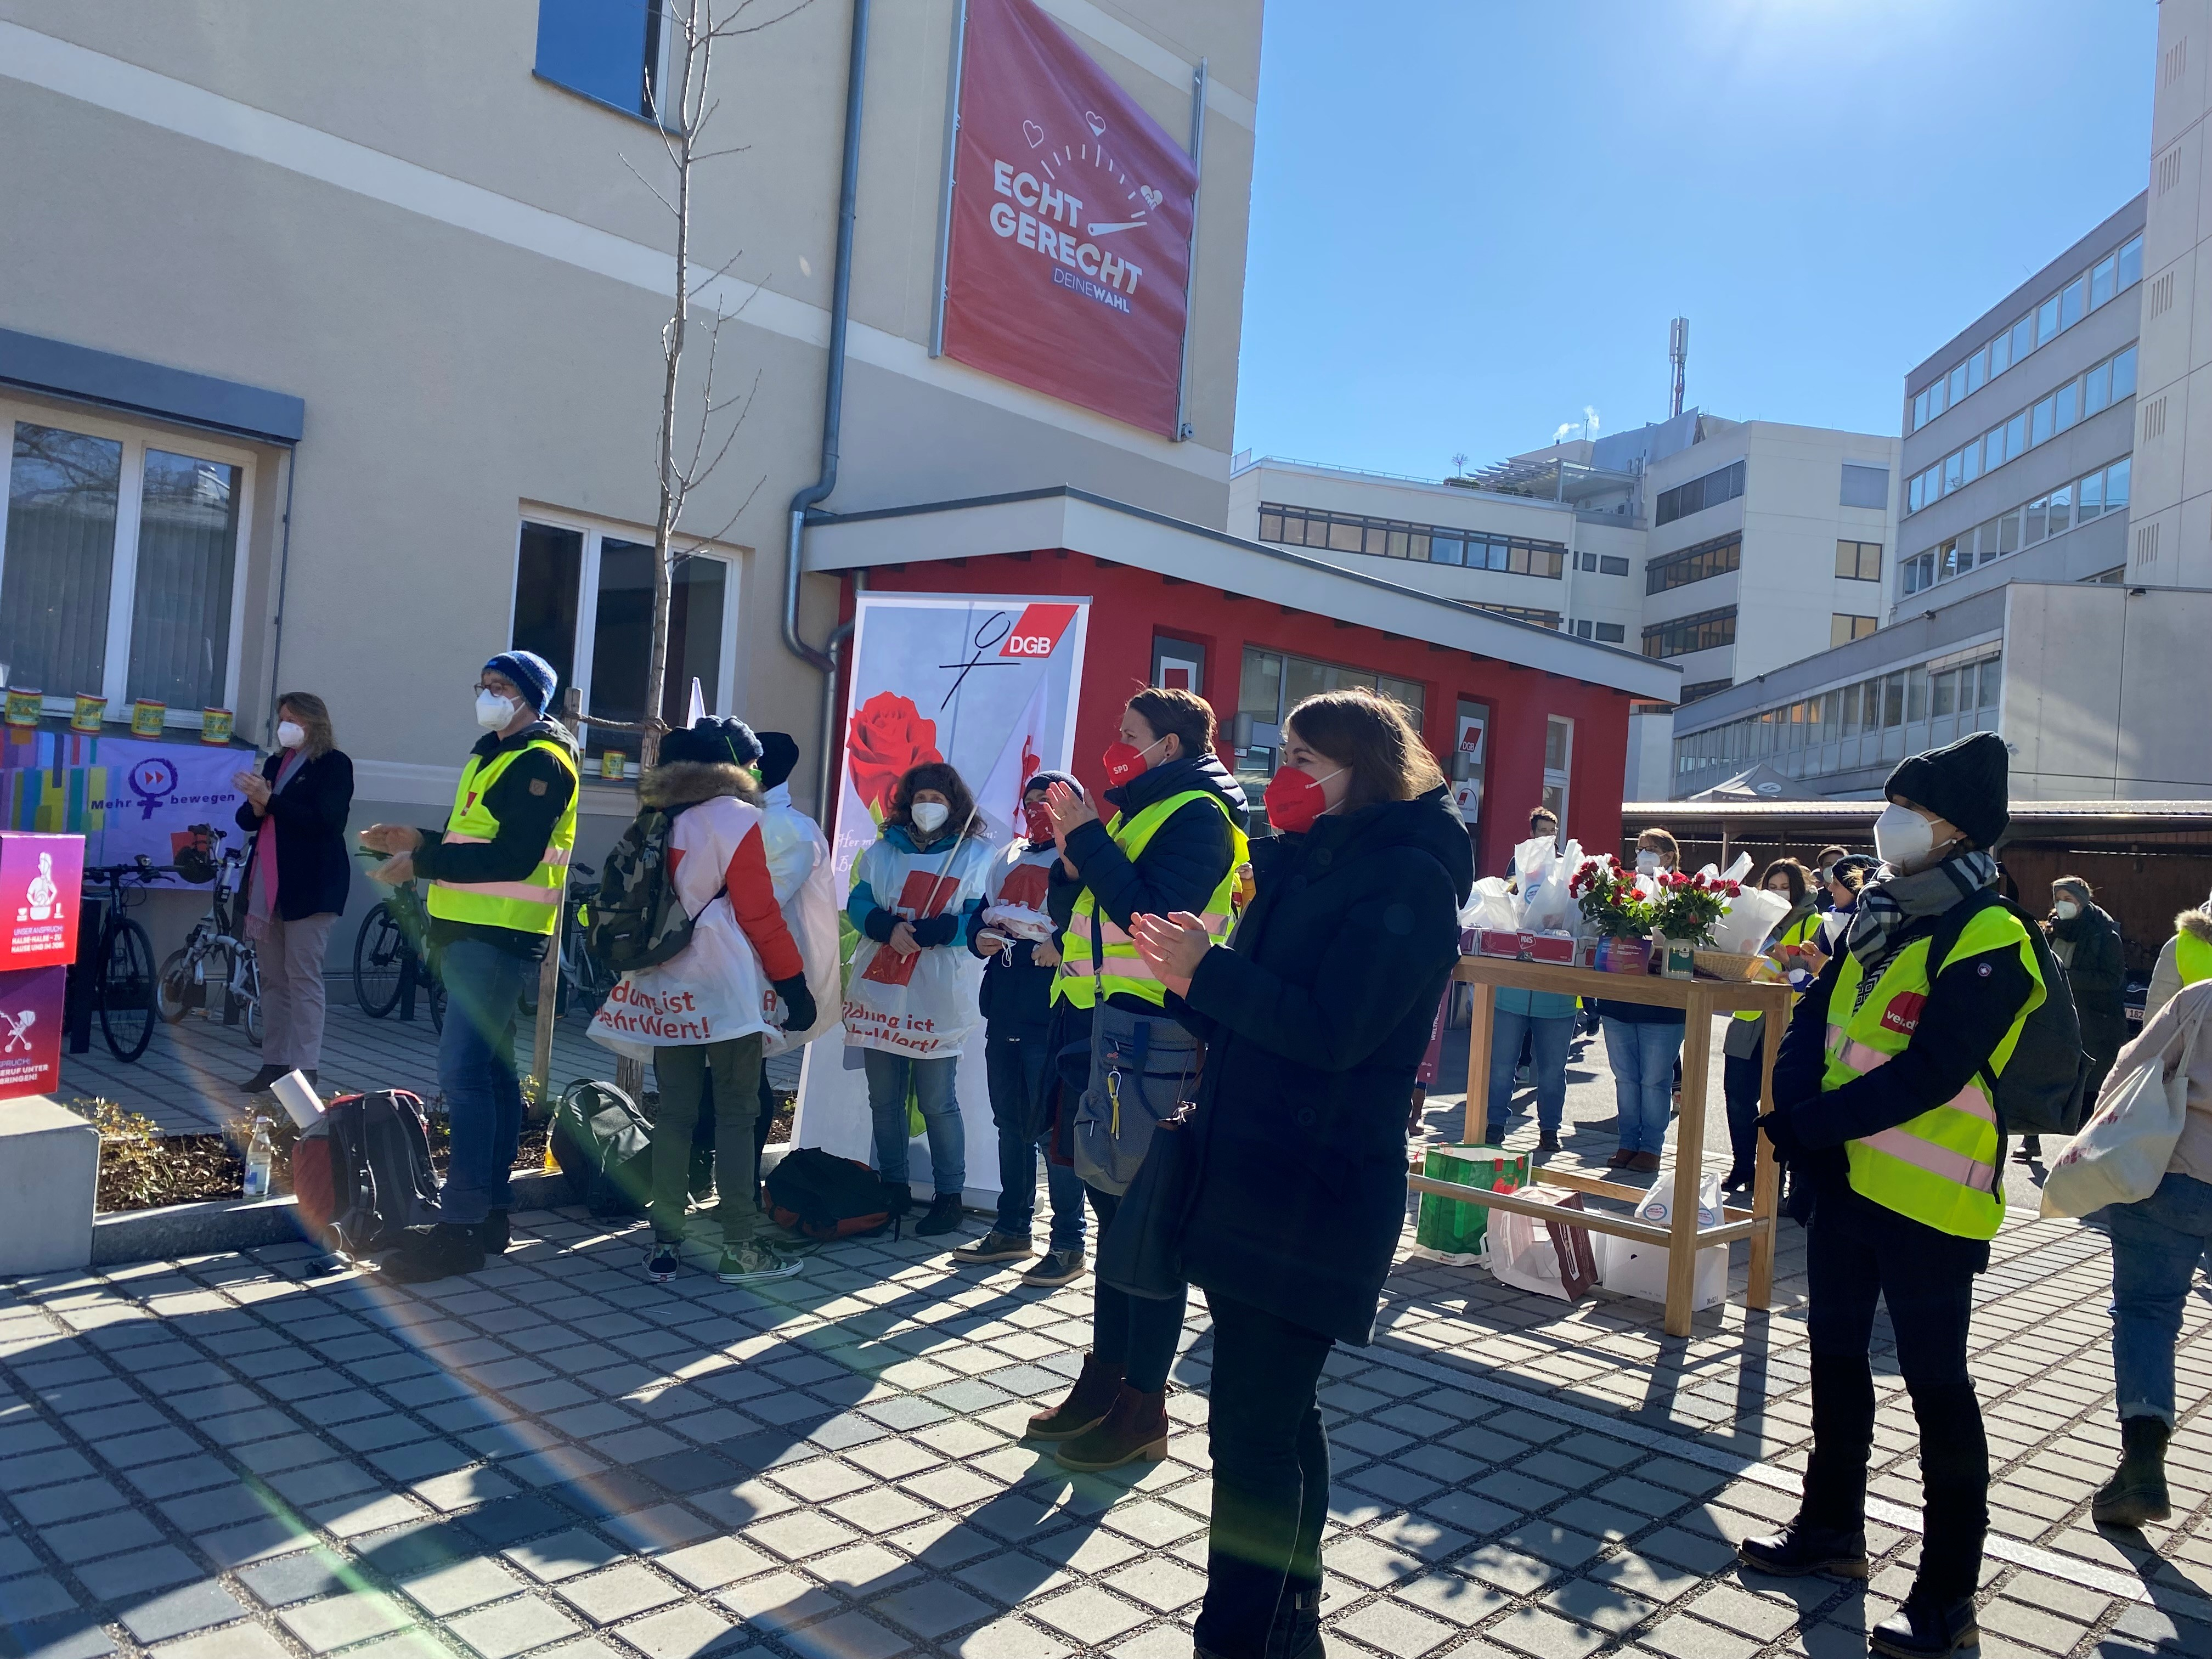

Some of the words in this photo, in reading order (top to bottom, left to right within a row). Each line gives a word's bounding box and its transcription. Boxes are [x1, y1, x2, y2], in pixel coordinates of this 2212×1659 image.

[994, 159, 1083, 228] ECHT
[990, 202, 1143, 295] GERECHT
[1009, 636, 1051, 654] DGB
[1462, 741, 1475, 751] DGB
[1113, 764, 1128, 775] SPD
[91, 798, 132, 810] Mehr
[170, 794, 235, 804] bewegen
[662, 991, 696, 1013] ist
[907, 1014, 934, 1033] ist
[22, 1064, 48, 1073] UNTER
